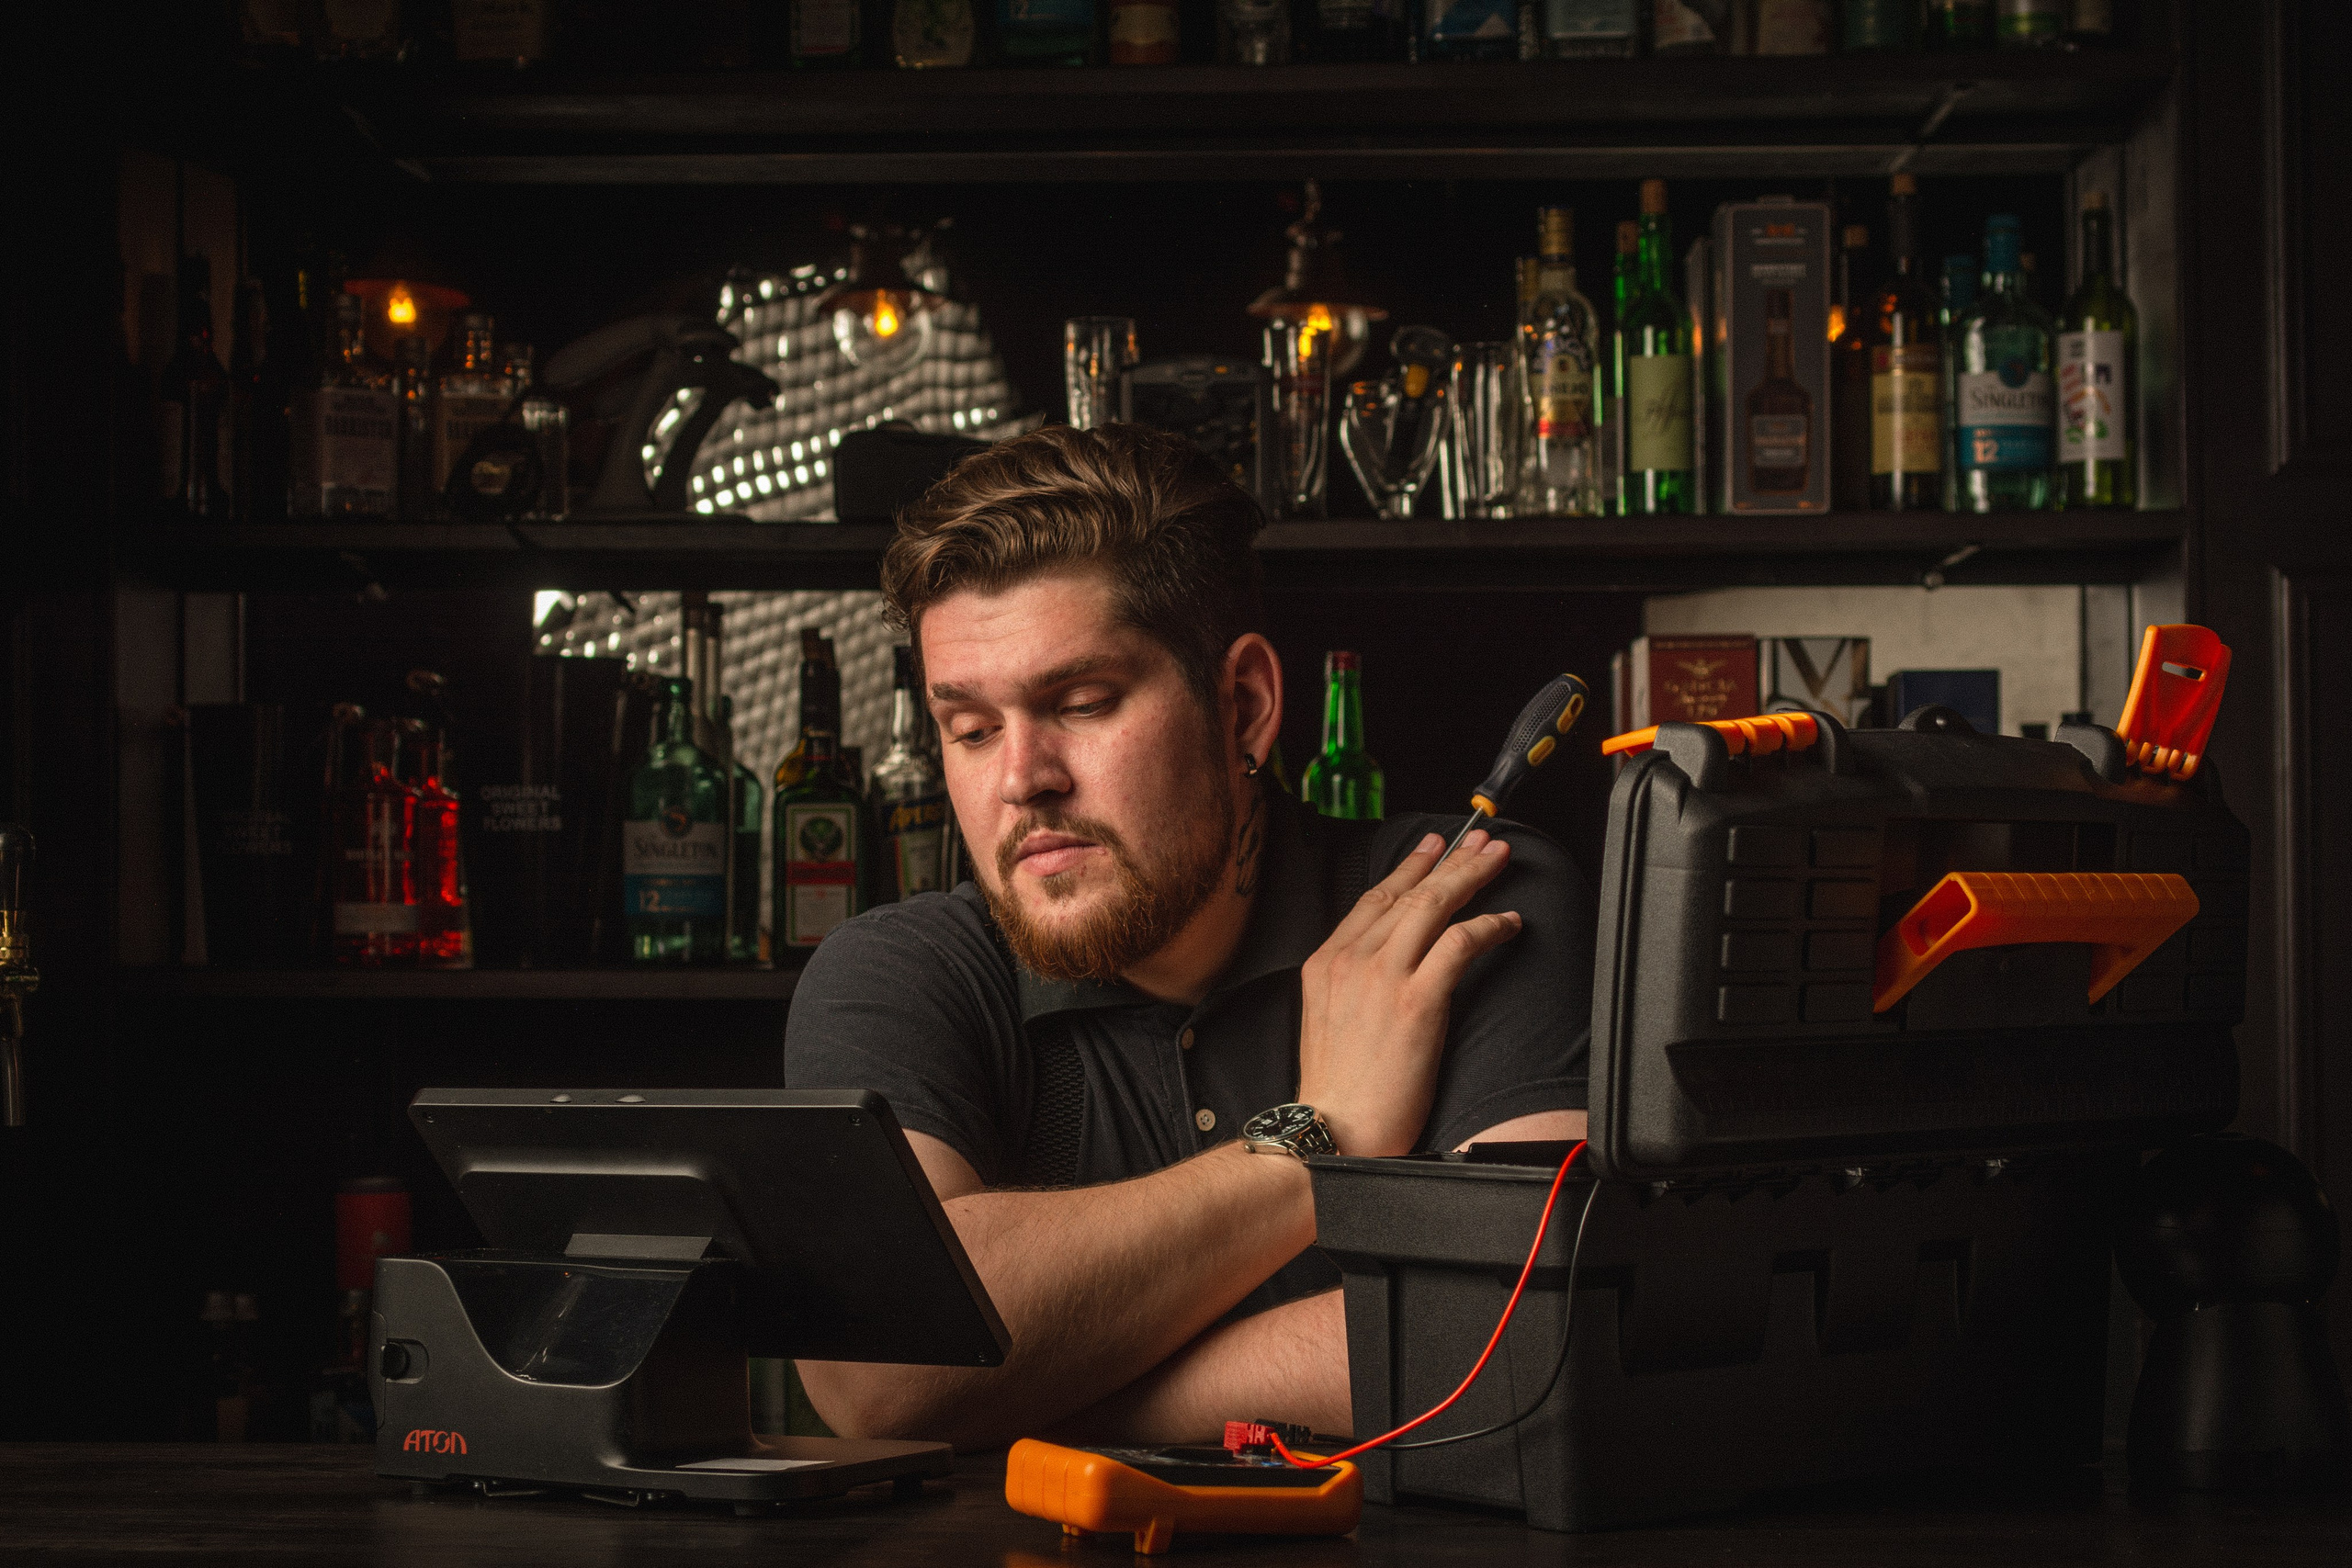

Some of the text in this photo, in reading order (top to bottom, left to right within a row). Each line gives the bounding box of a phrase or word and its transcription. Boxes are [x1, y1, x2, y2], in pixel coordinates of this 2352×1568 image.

[1973, 439, 1999, 464] 12
[479, 784, 562, 802] ORIGINAL
[490, 801, 549, 817] SWEET
[481, 816, 563, 832] FLOWERS
[639, 888, 662, 914] 12
[402, 1428, 469, 1456] ATON
